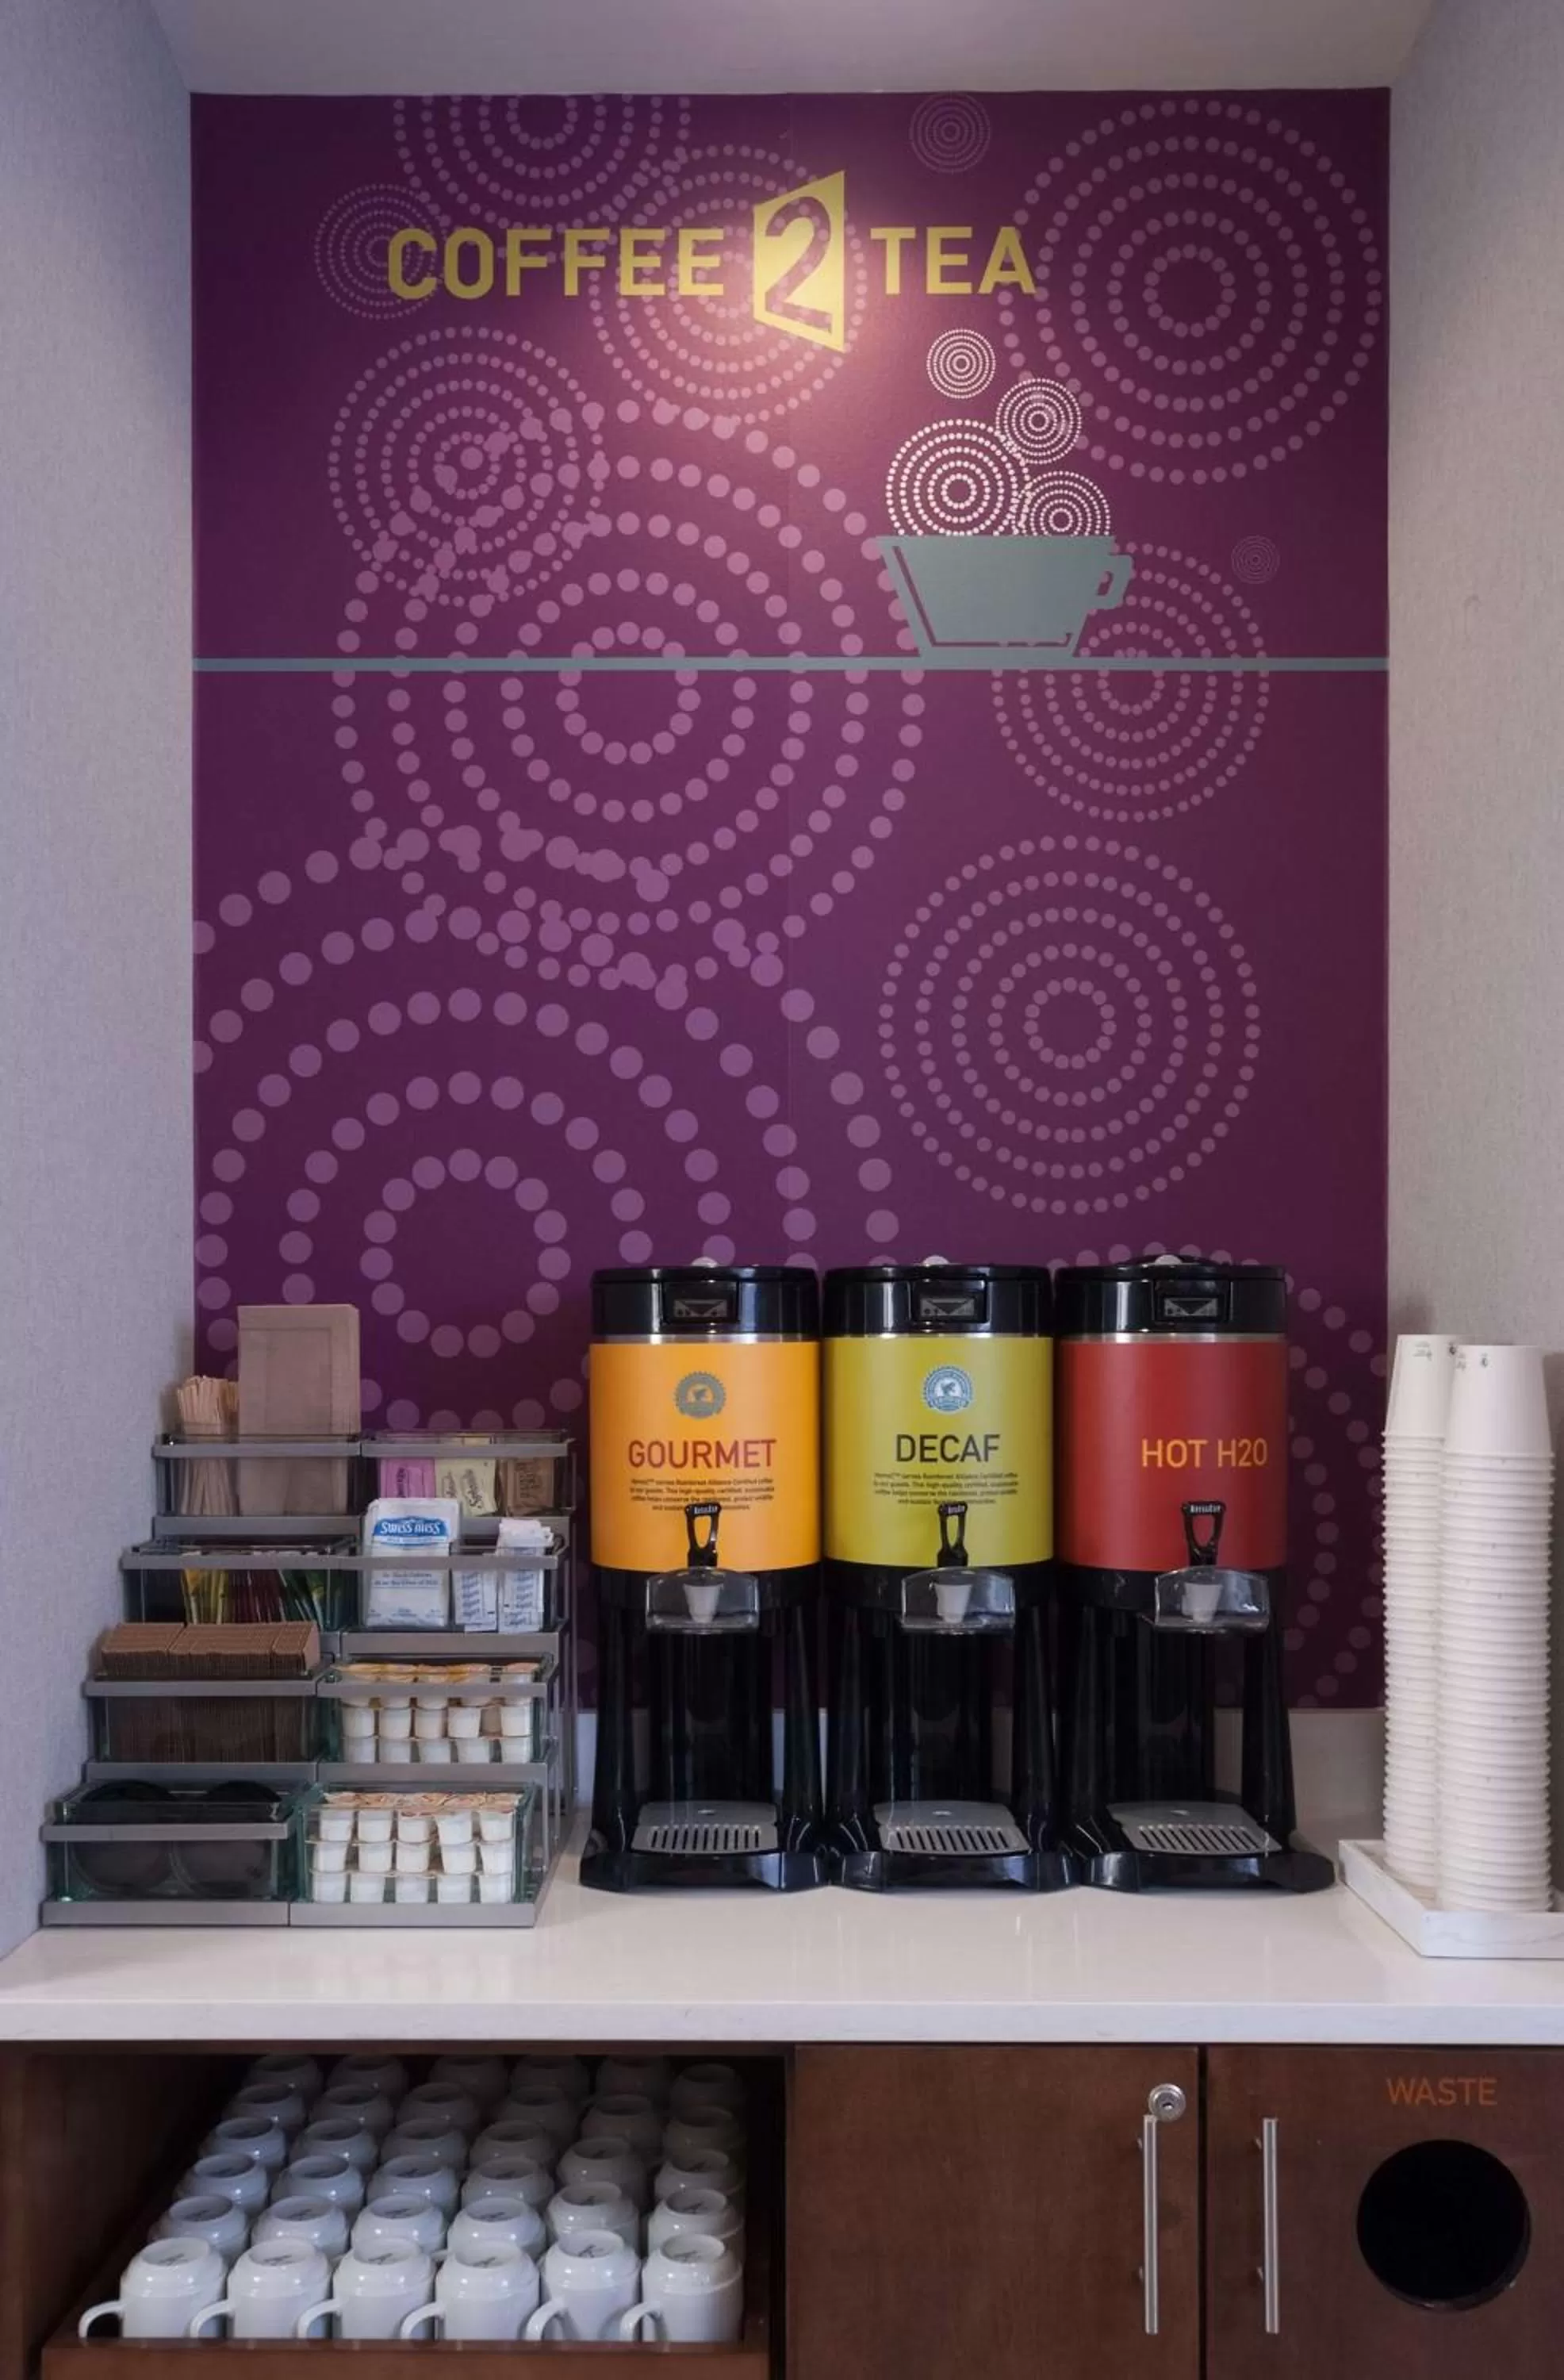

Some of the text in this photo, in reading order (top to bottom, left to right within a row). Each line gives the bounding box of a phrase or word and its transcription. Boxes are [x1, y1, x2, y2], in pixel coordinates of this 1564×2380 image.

[387, 195, 1036, 336] COFFEE 2 TEA
[628, 1438, 777, 1468] GOURMET
[896, 1434, 1001, 1462] DECAF
[1141, 1438, 1209, 1468] HOT
[1386, 2078, 1497, 2106] WASTE
